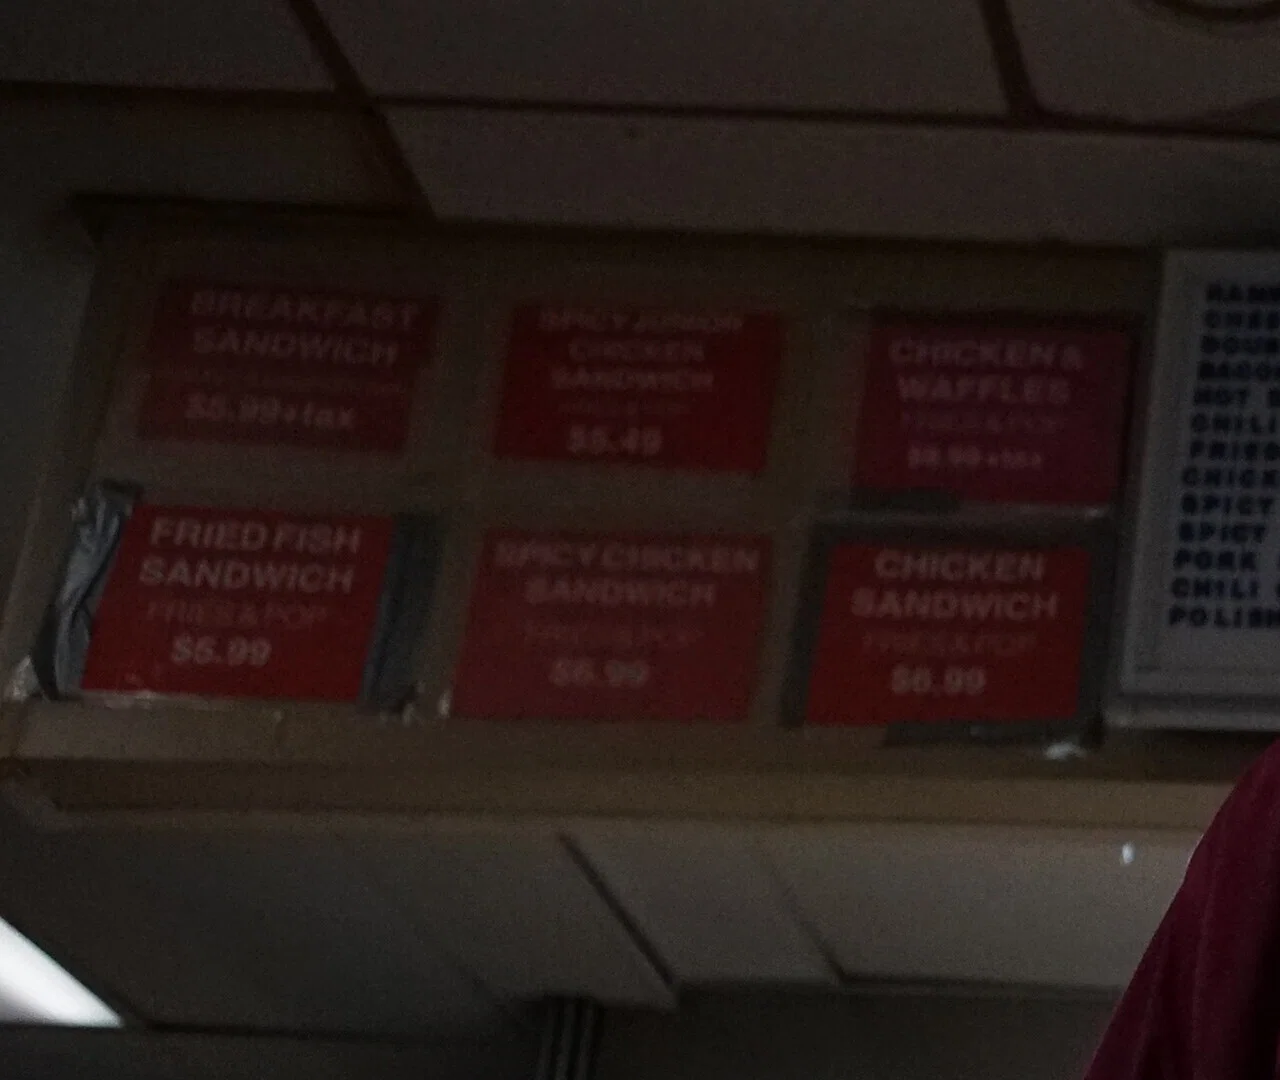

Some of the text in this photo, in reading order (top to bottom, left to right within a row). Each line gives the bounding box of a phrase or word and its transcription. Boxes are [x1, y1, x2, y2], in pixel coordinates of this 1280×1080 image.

[191, 291, 420, 330] BREAKFAST
[193, 327, 399, 366] SANDWICH
[568, 338, 706, 362] CHICKEN
[888, 337, 1056, 370] CHICKEN
[550, 366, 715, 391] SANDWICH
[896, 373, 1071, 405] WAFFLES
[1193, 388, 1249, 408] HOT
[1190, 413, 1278, 434] CHILI
[1181, 494, 1274, 515] SPICY
[149, 516, 361, 554] FRIED FISH
[1178, 522, 1266, 543] SPICY
[494, 539, 761, 574] SPICY CHICKEN
[874, 548, 1047, 583] CHICKEN
[1174, 549, 1256, 571] PORK
[138, 554, 354, 594] SANDWICH
[1171, 577, 1258, 599] CHILI
[524, 575, 718, 609] SANDWICH
[850, 586, 1060, 621] SANDWICH
